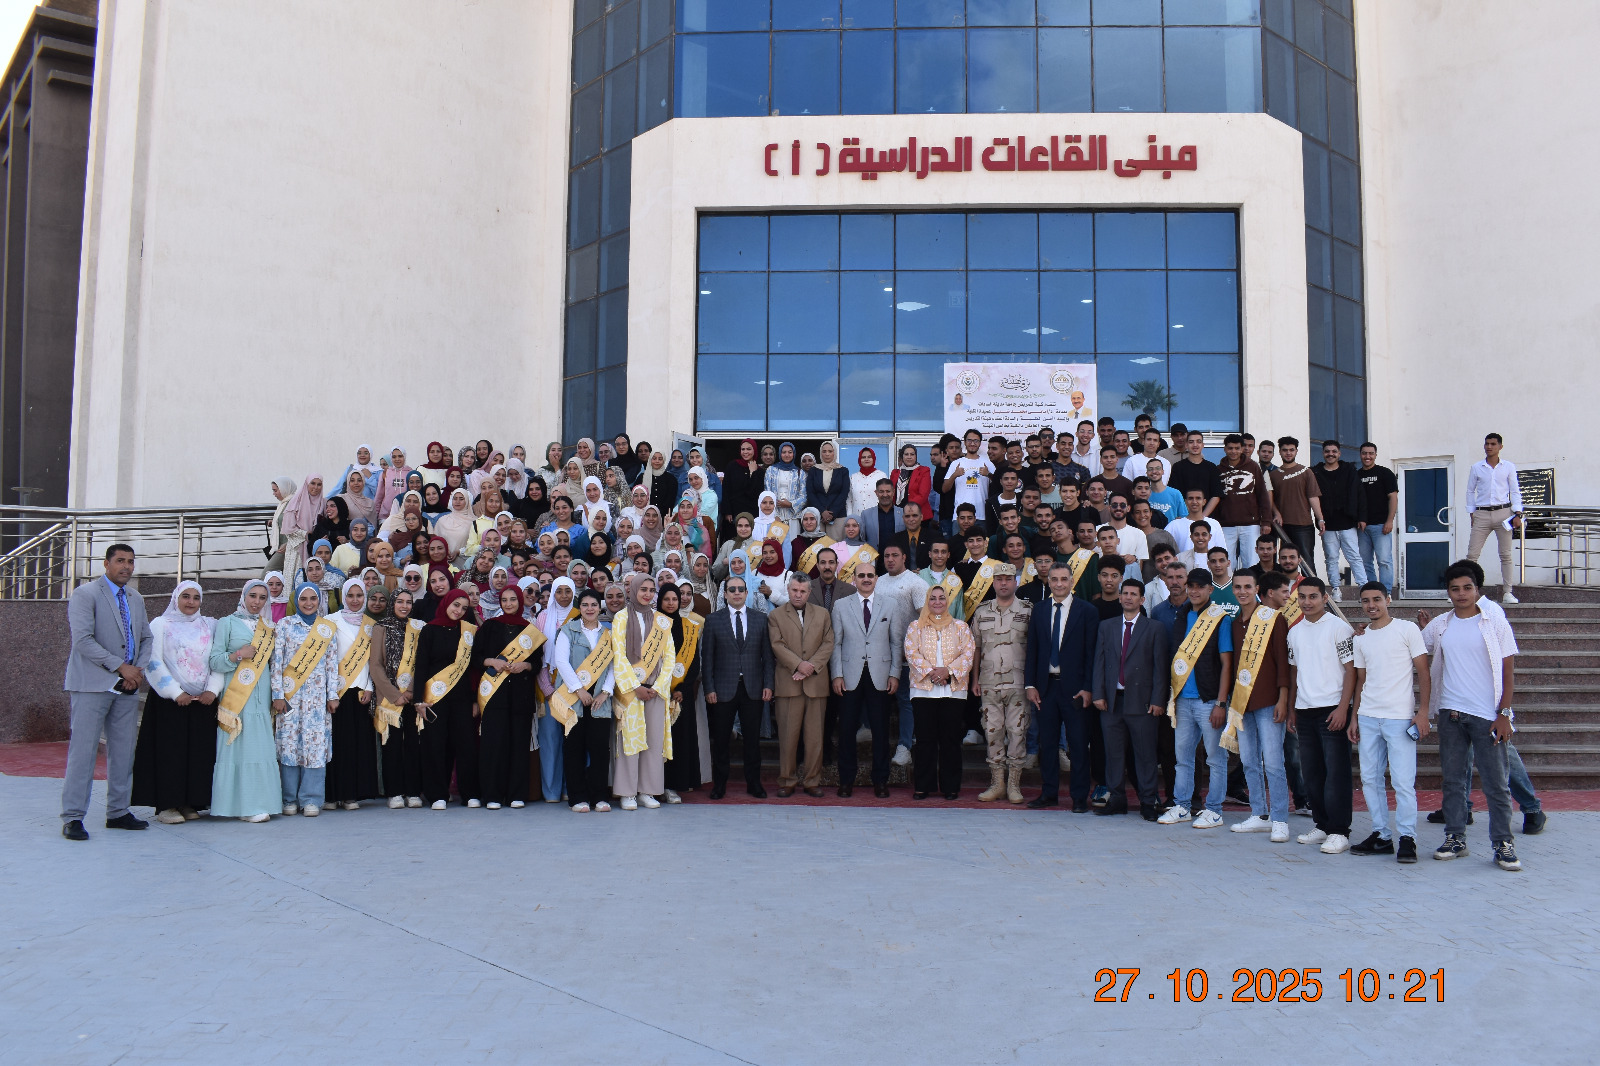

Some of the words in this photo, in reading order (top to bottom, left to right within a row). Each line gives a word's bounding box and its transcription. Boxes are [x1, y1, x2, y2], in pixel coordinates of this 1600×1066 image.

[838, 137, 972, 180] الدراسية
[982, 134, 1107, 172] القاعات
[1114, 134, 1198, 180] مبنى
